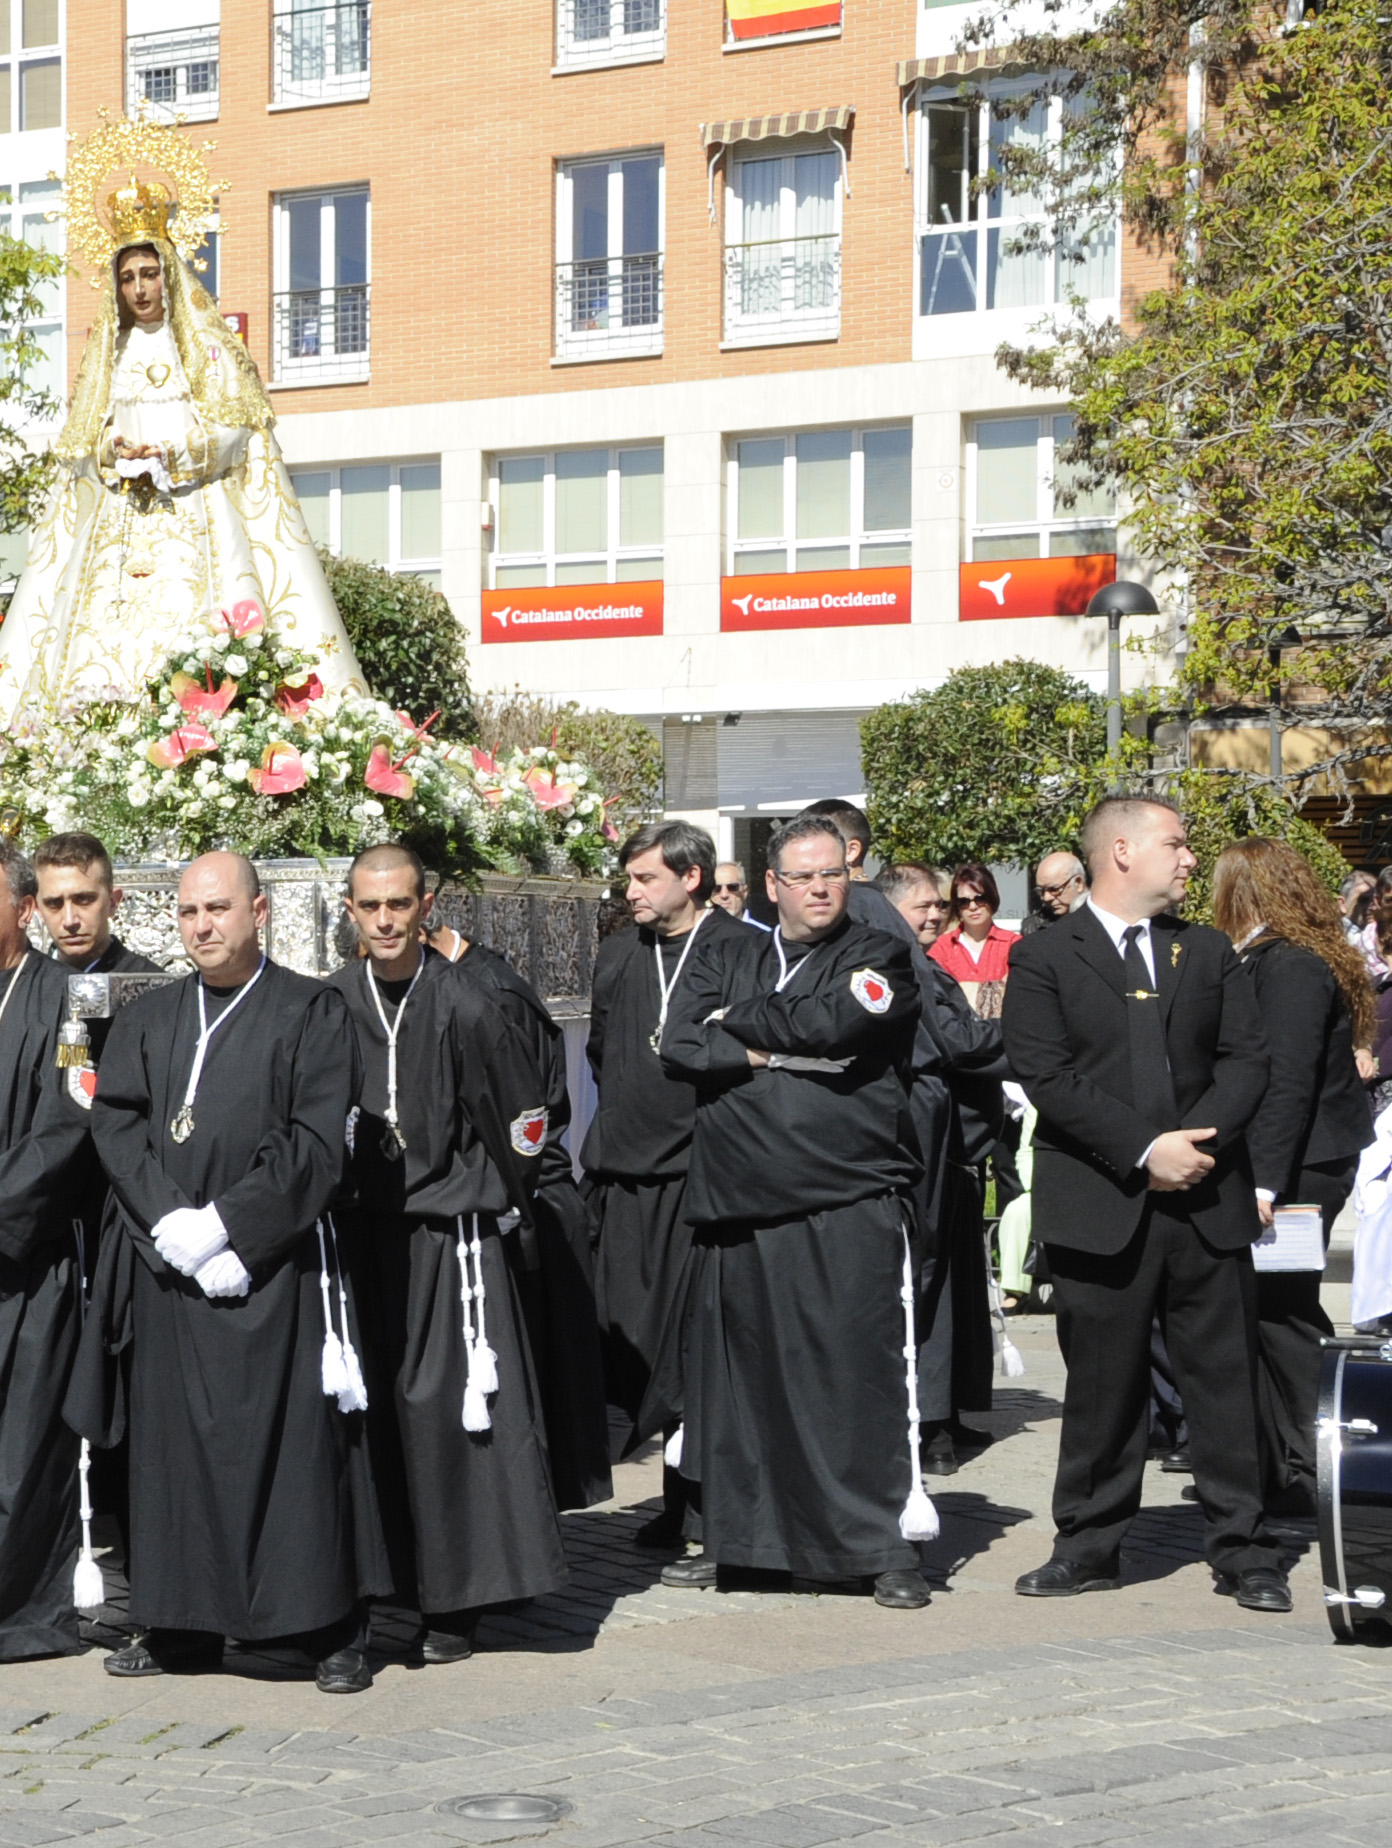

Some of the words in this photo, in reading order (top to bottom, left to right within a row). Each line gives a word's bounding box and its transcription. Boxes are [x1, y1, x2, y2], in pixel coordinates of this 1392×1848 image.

[753, 596, 820, 612] Catalana
[821, 591, 897, 608] Occidente
[511, 608, 573, 624] Catalana
[574, 605, 644, 620] Occidente
